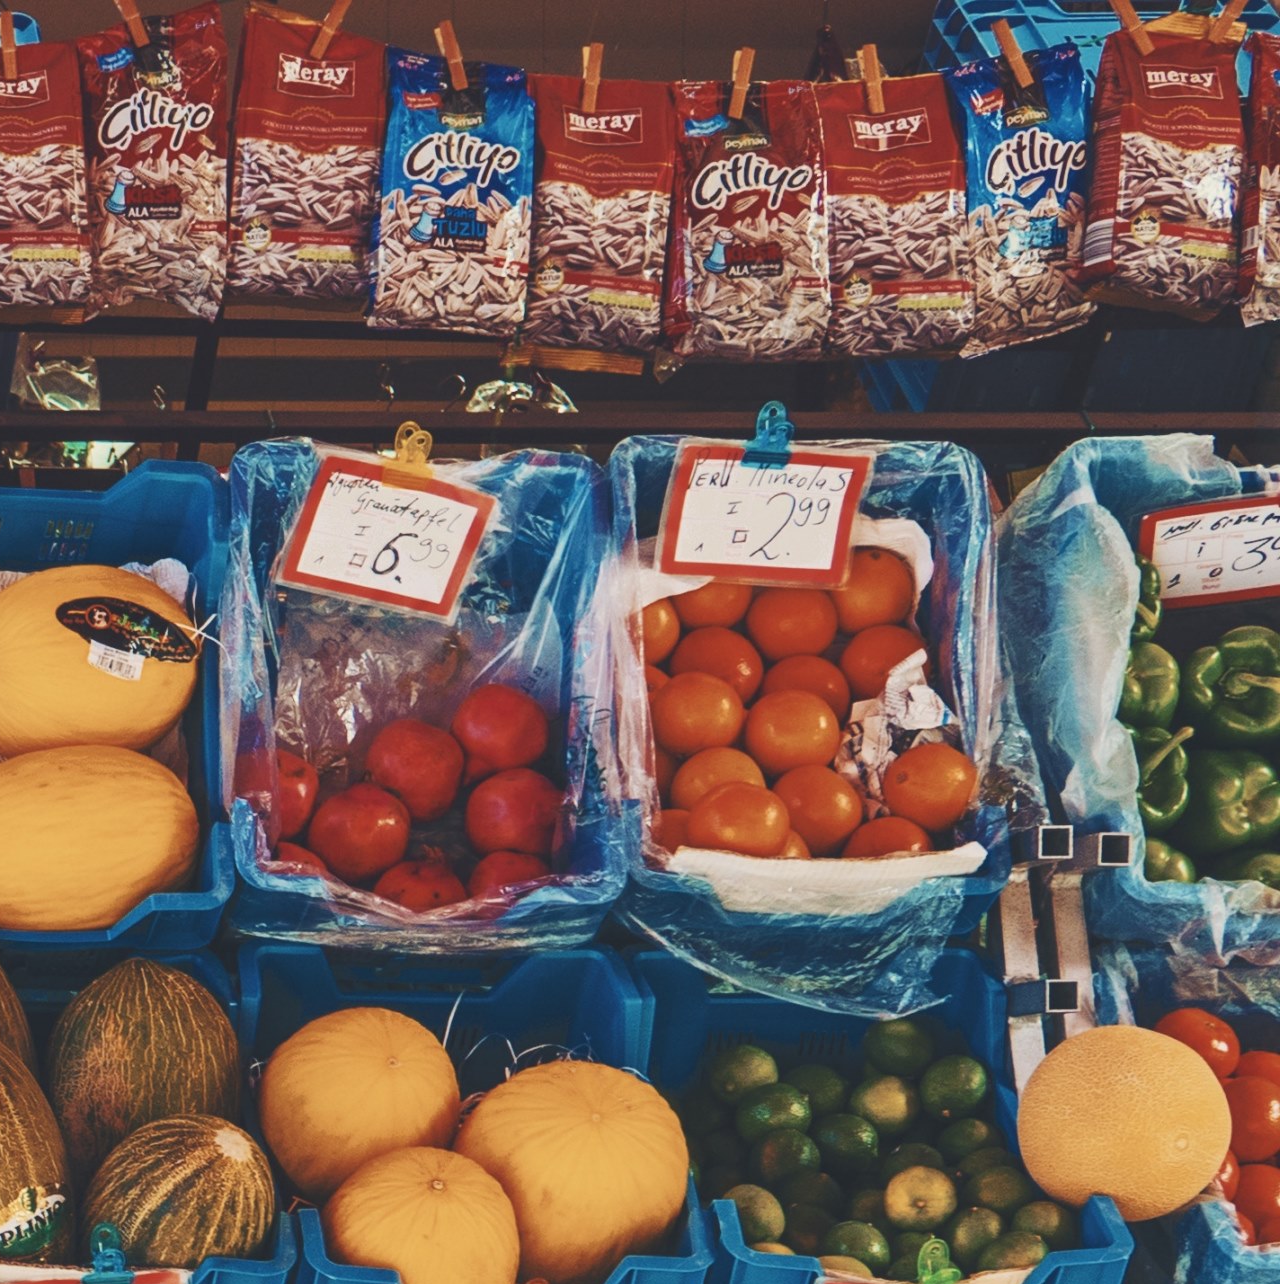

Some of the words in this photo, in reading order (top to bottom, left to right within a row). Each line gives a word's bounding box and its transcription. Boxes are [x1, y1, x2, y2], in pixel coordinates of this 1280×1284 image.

[1146, 68, 1215, 90] meray
[441, 115, 483, 129] peyman
[568, 111, 637, 132] meray
[854, 113, 924, 135] meray
[1005, 109, 1048, 127] peyman
[724, 136, 768, 149] peyman
[128, 206, 150, 218] ALA
[433, 237, 455, 248] ALA
[728, 265, 751, 277] ALA
